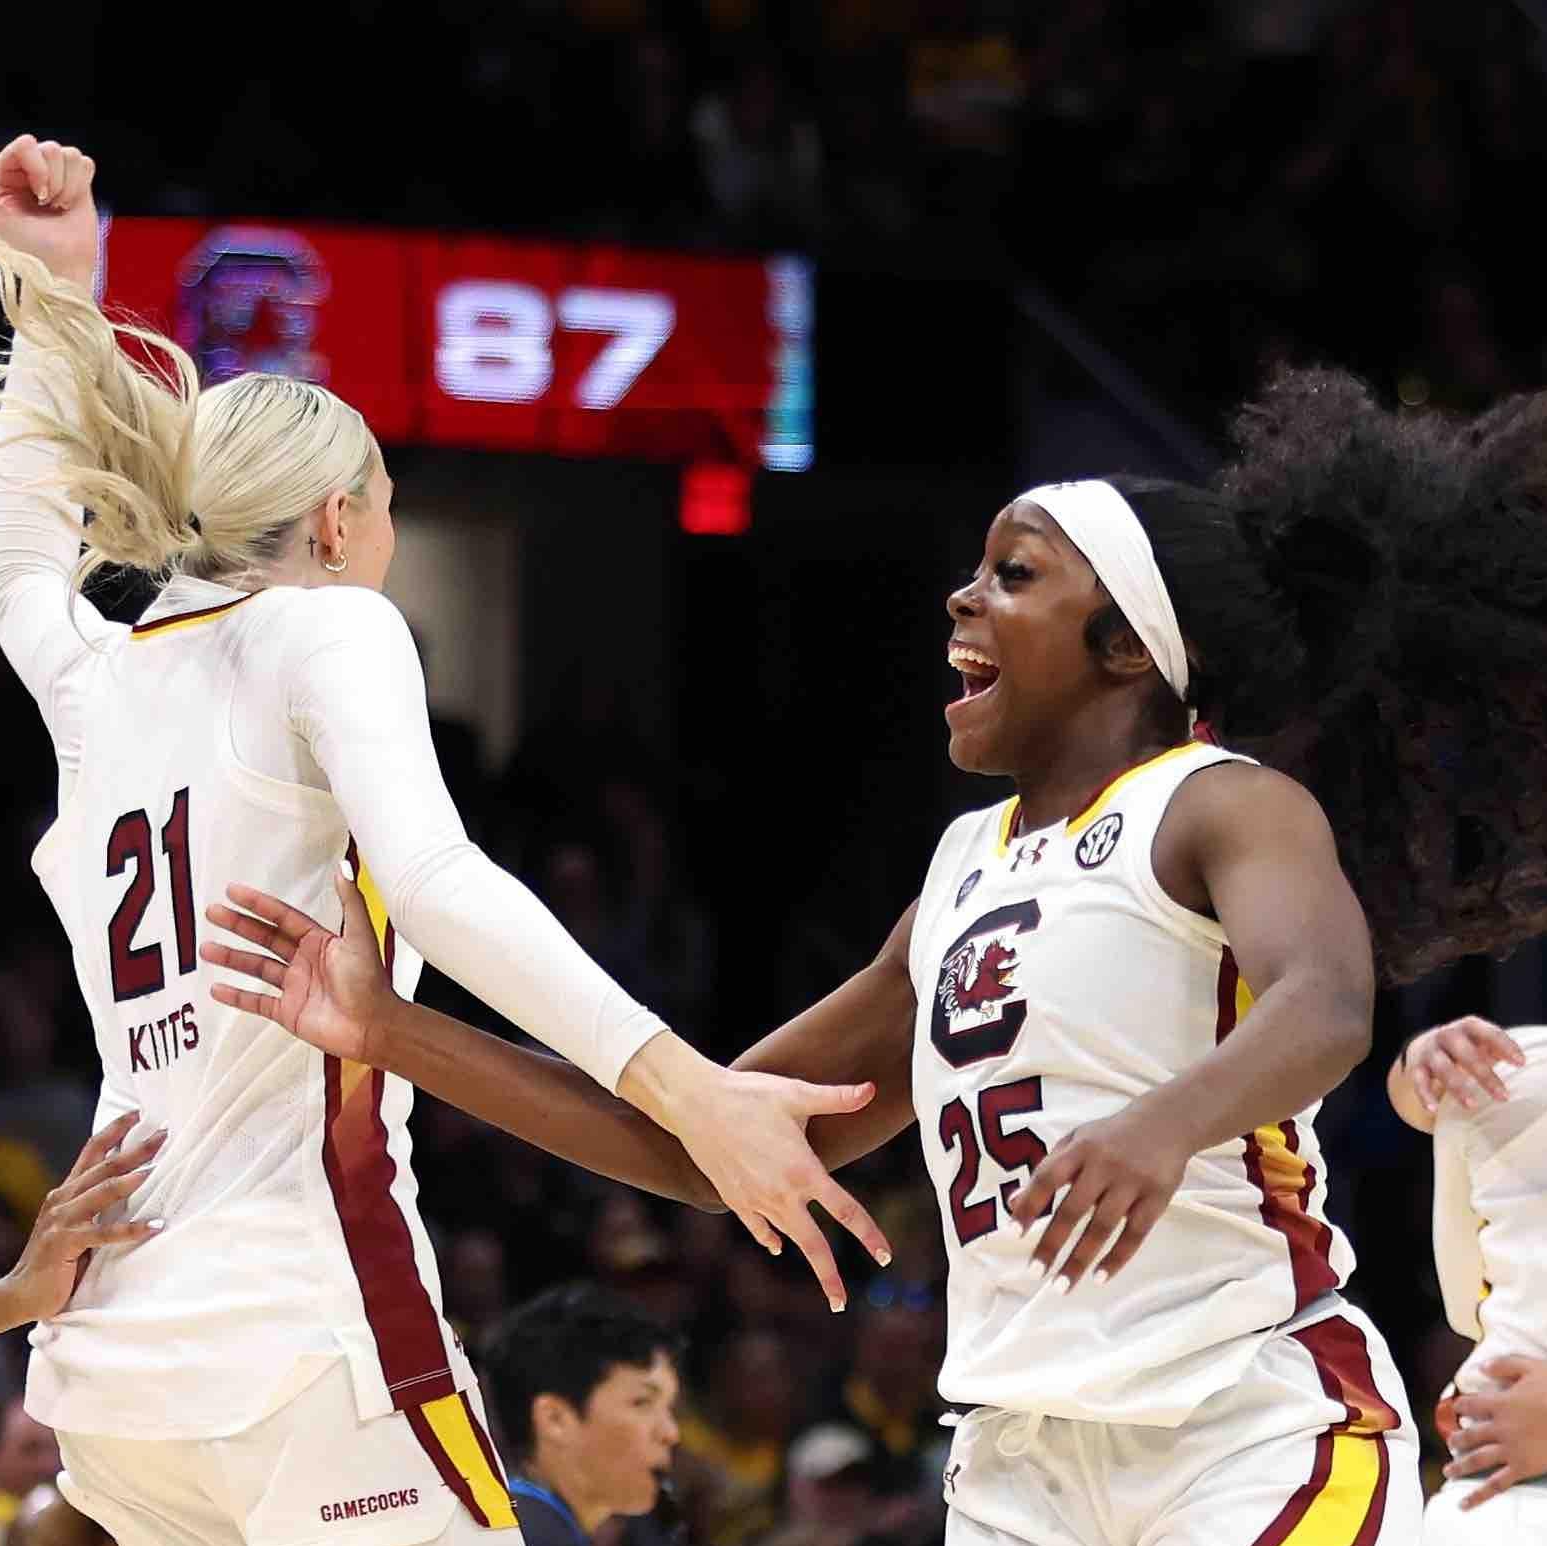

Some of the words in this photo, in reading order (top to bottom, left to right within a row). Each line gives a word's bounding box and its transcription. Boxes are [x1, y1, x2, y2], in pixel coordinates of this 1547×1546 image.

[435, 279, 677, 410] 87
[106, 786, 197, 1003] 21
[128, 1002, 199, 1074] KITTS
[938, 1074, 1056, 1248] 25
[320, 1487, 419, 1523] GAMECOCKS
